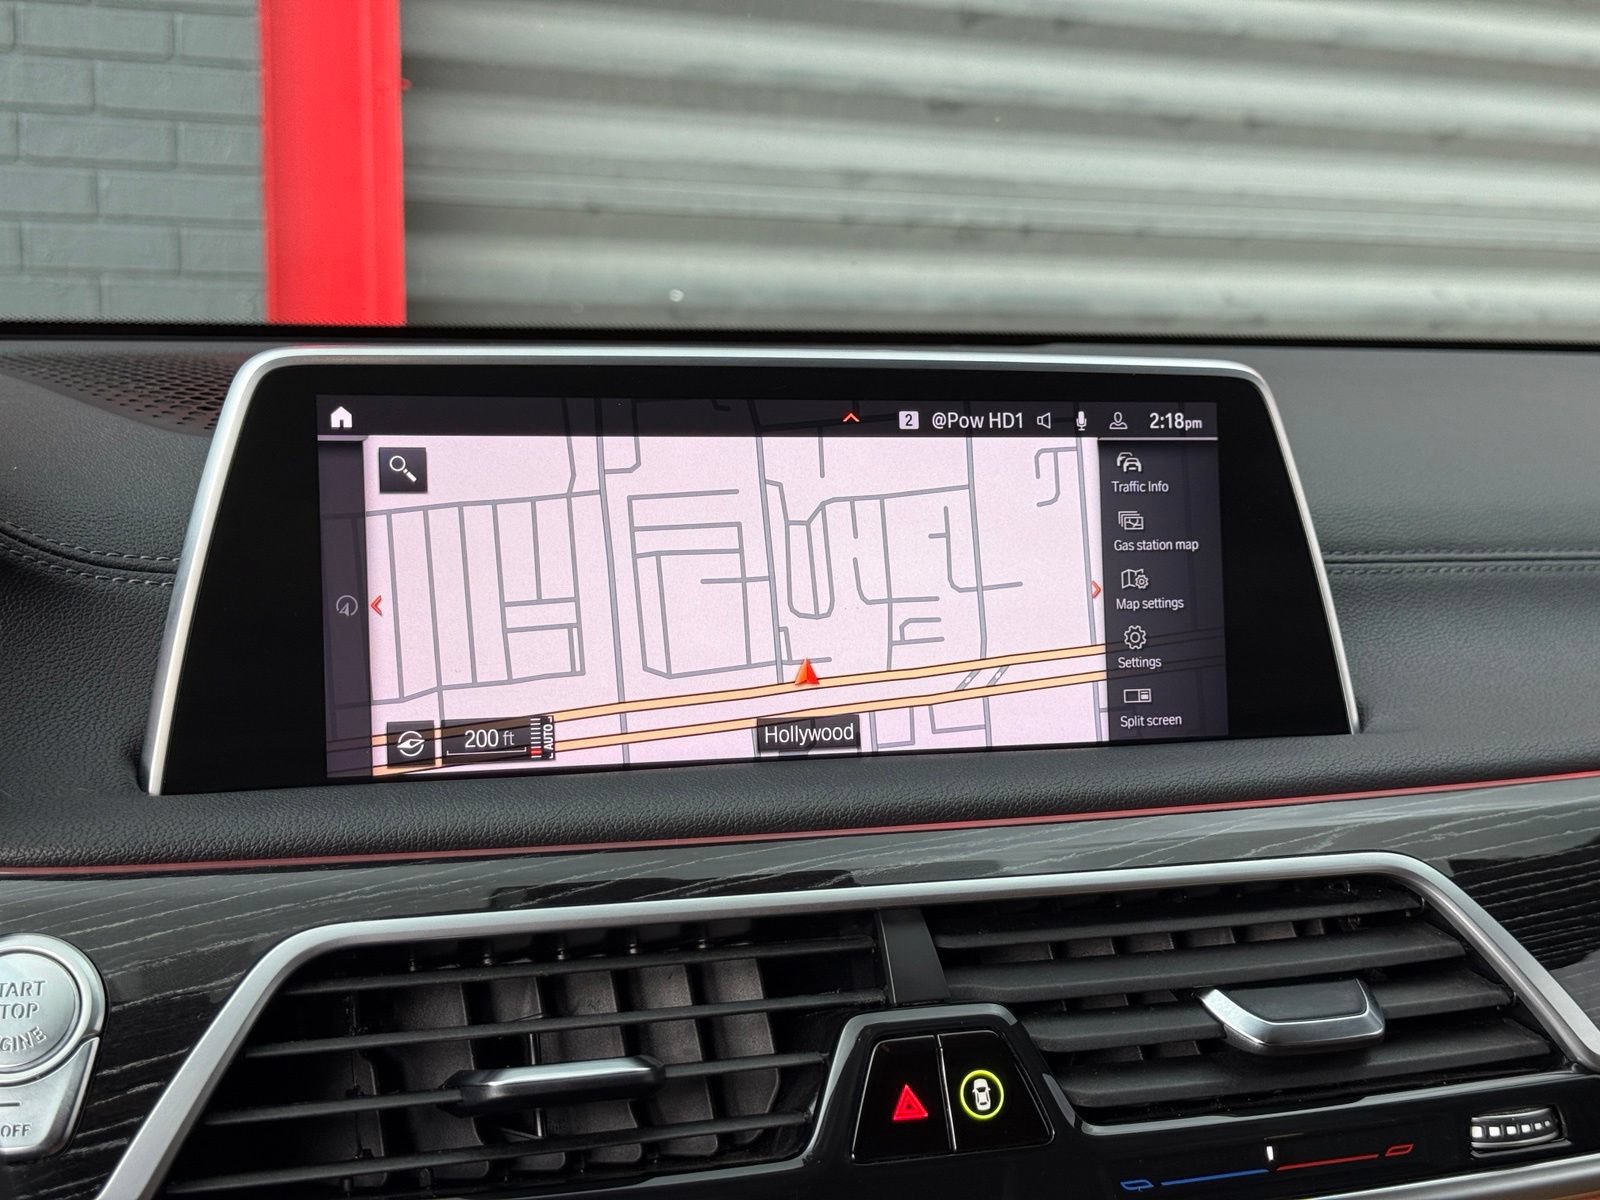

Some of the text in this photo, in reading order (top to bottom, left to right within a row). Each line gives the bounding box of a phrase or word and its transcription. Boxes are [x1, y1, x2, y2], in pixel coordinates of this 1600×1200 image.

[932, 412, 984, 429] @Pow
[989, 412, 1023, 429] HD1
[1111, 480, 1169, 493] Traffic Info
[1113, 539, 1199, 552] Gas station map
[1116, 597, 1185, 611] Map settings
[1118, 656, 1162, 670] Settings
[1120, 715, 1182, 729] Split screen
[464, 729, 515, 748] 200 ft
[543, 724, 554, 750] AUTO
[765, 722, 854, 746] Hollywood
[0, 1123, 31, 1138] OFF
